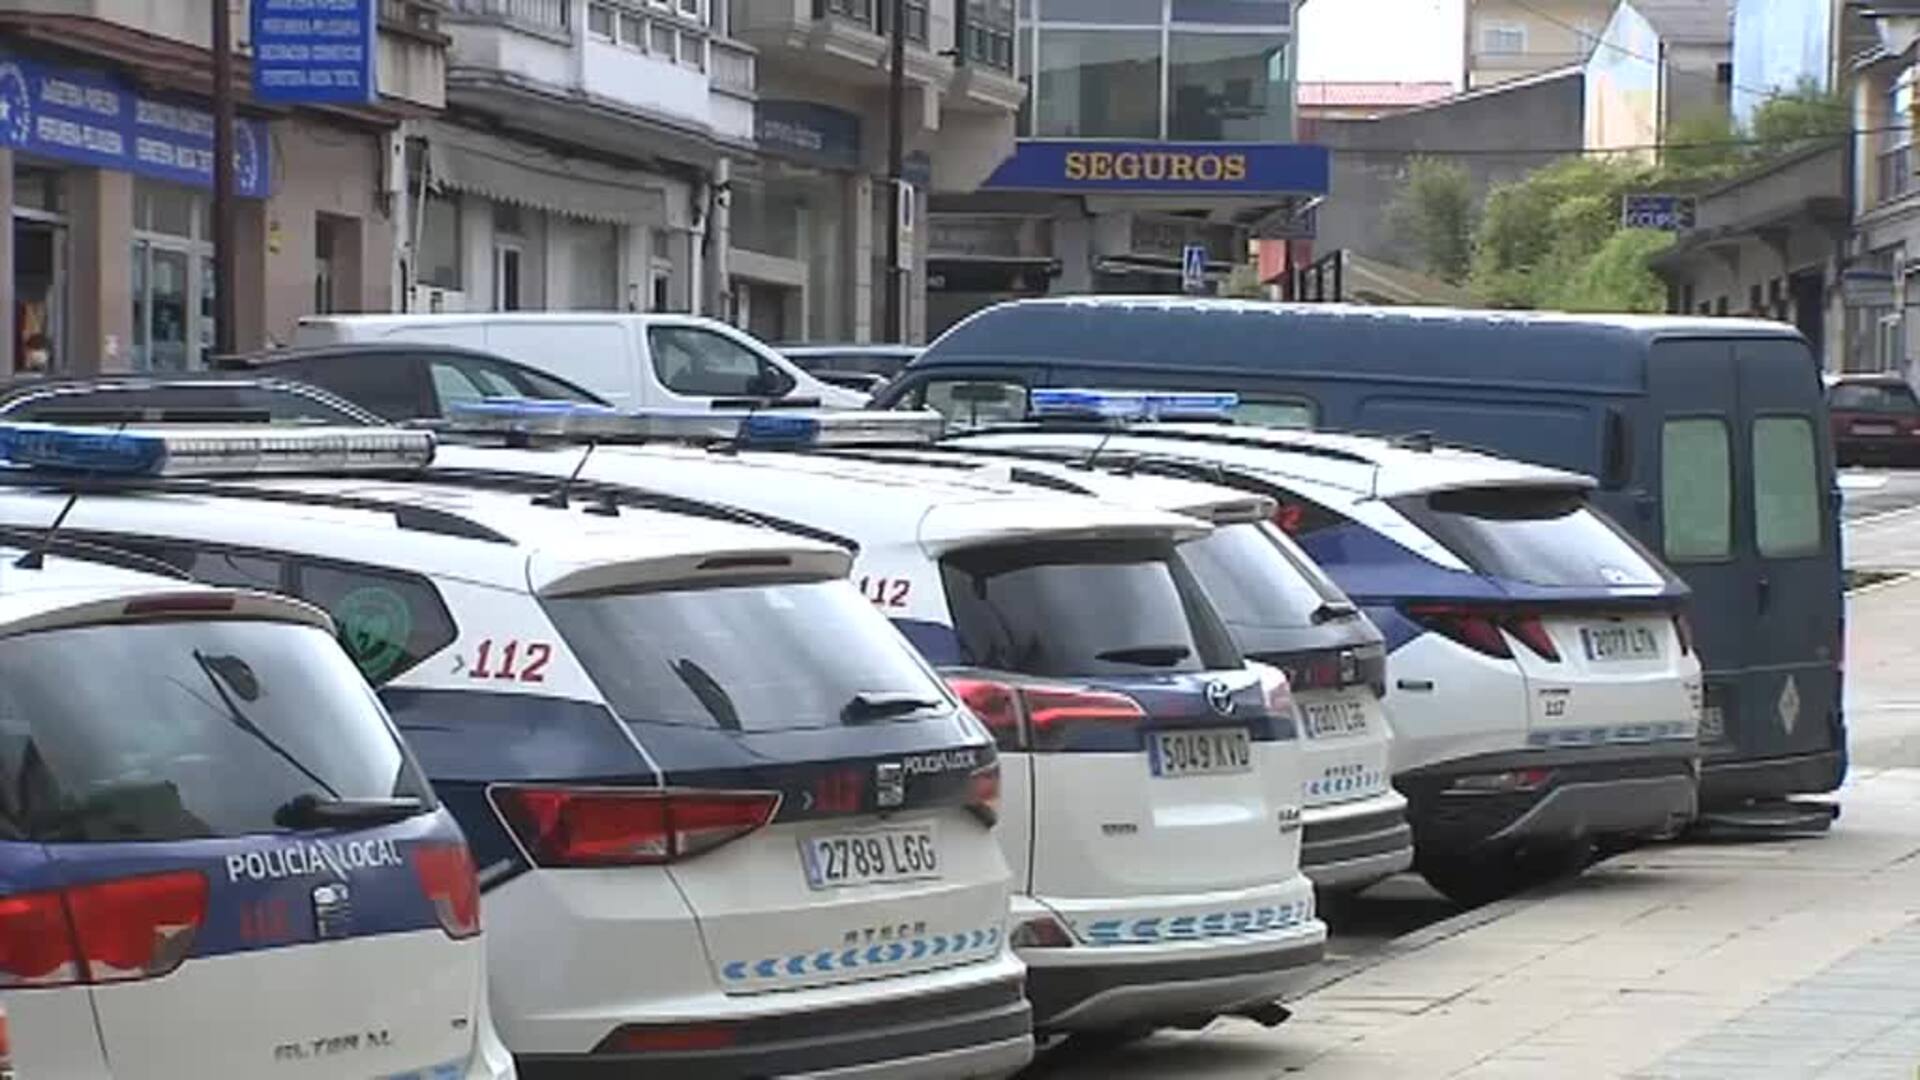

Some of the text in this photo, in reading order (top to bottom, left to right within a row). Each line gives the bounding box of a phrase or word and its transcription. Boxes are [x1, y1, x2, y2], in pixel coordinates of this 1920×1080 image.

[1064, 150, 1247, 181] SEGUROS
[468, 638, 552, 682] 112
[336, 838, 403, 870] LOCAL
[820, 834, 936, 880] 2789 LGG
